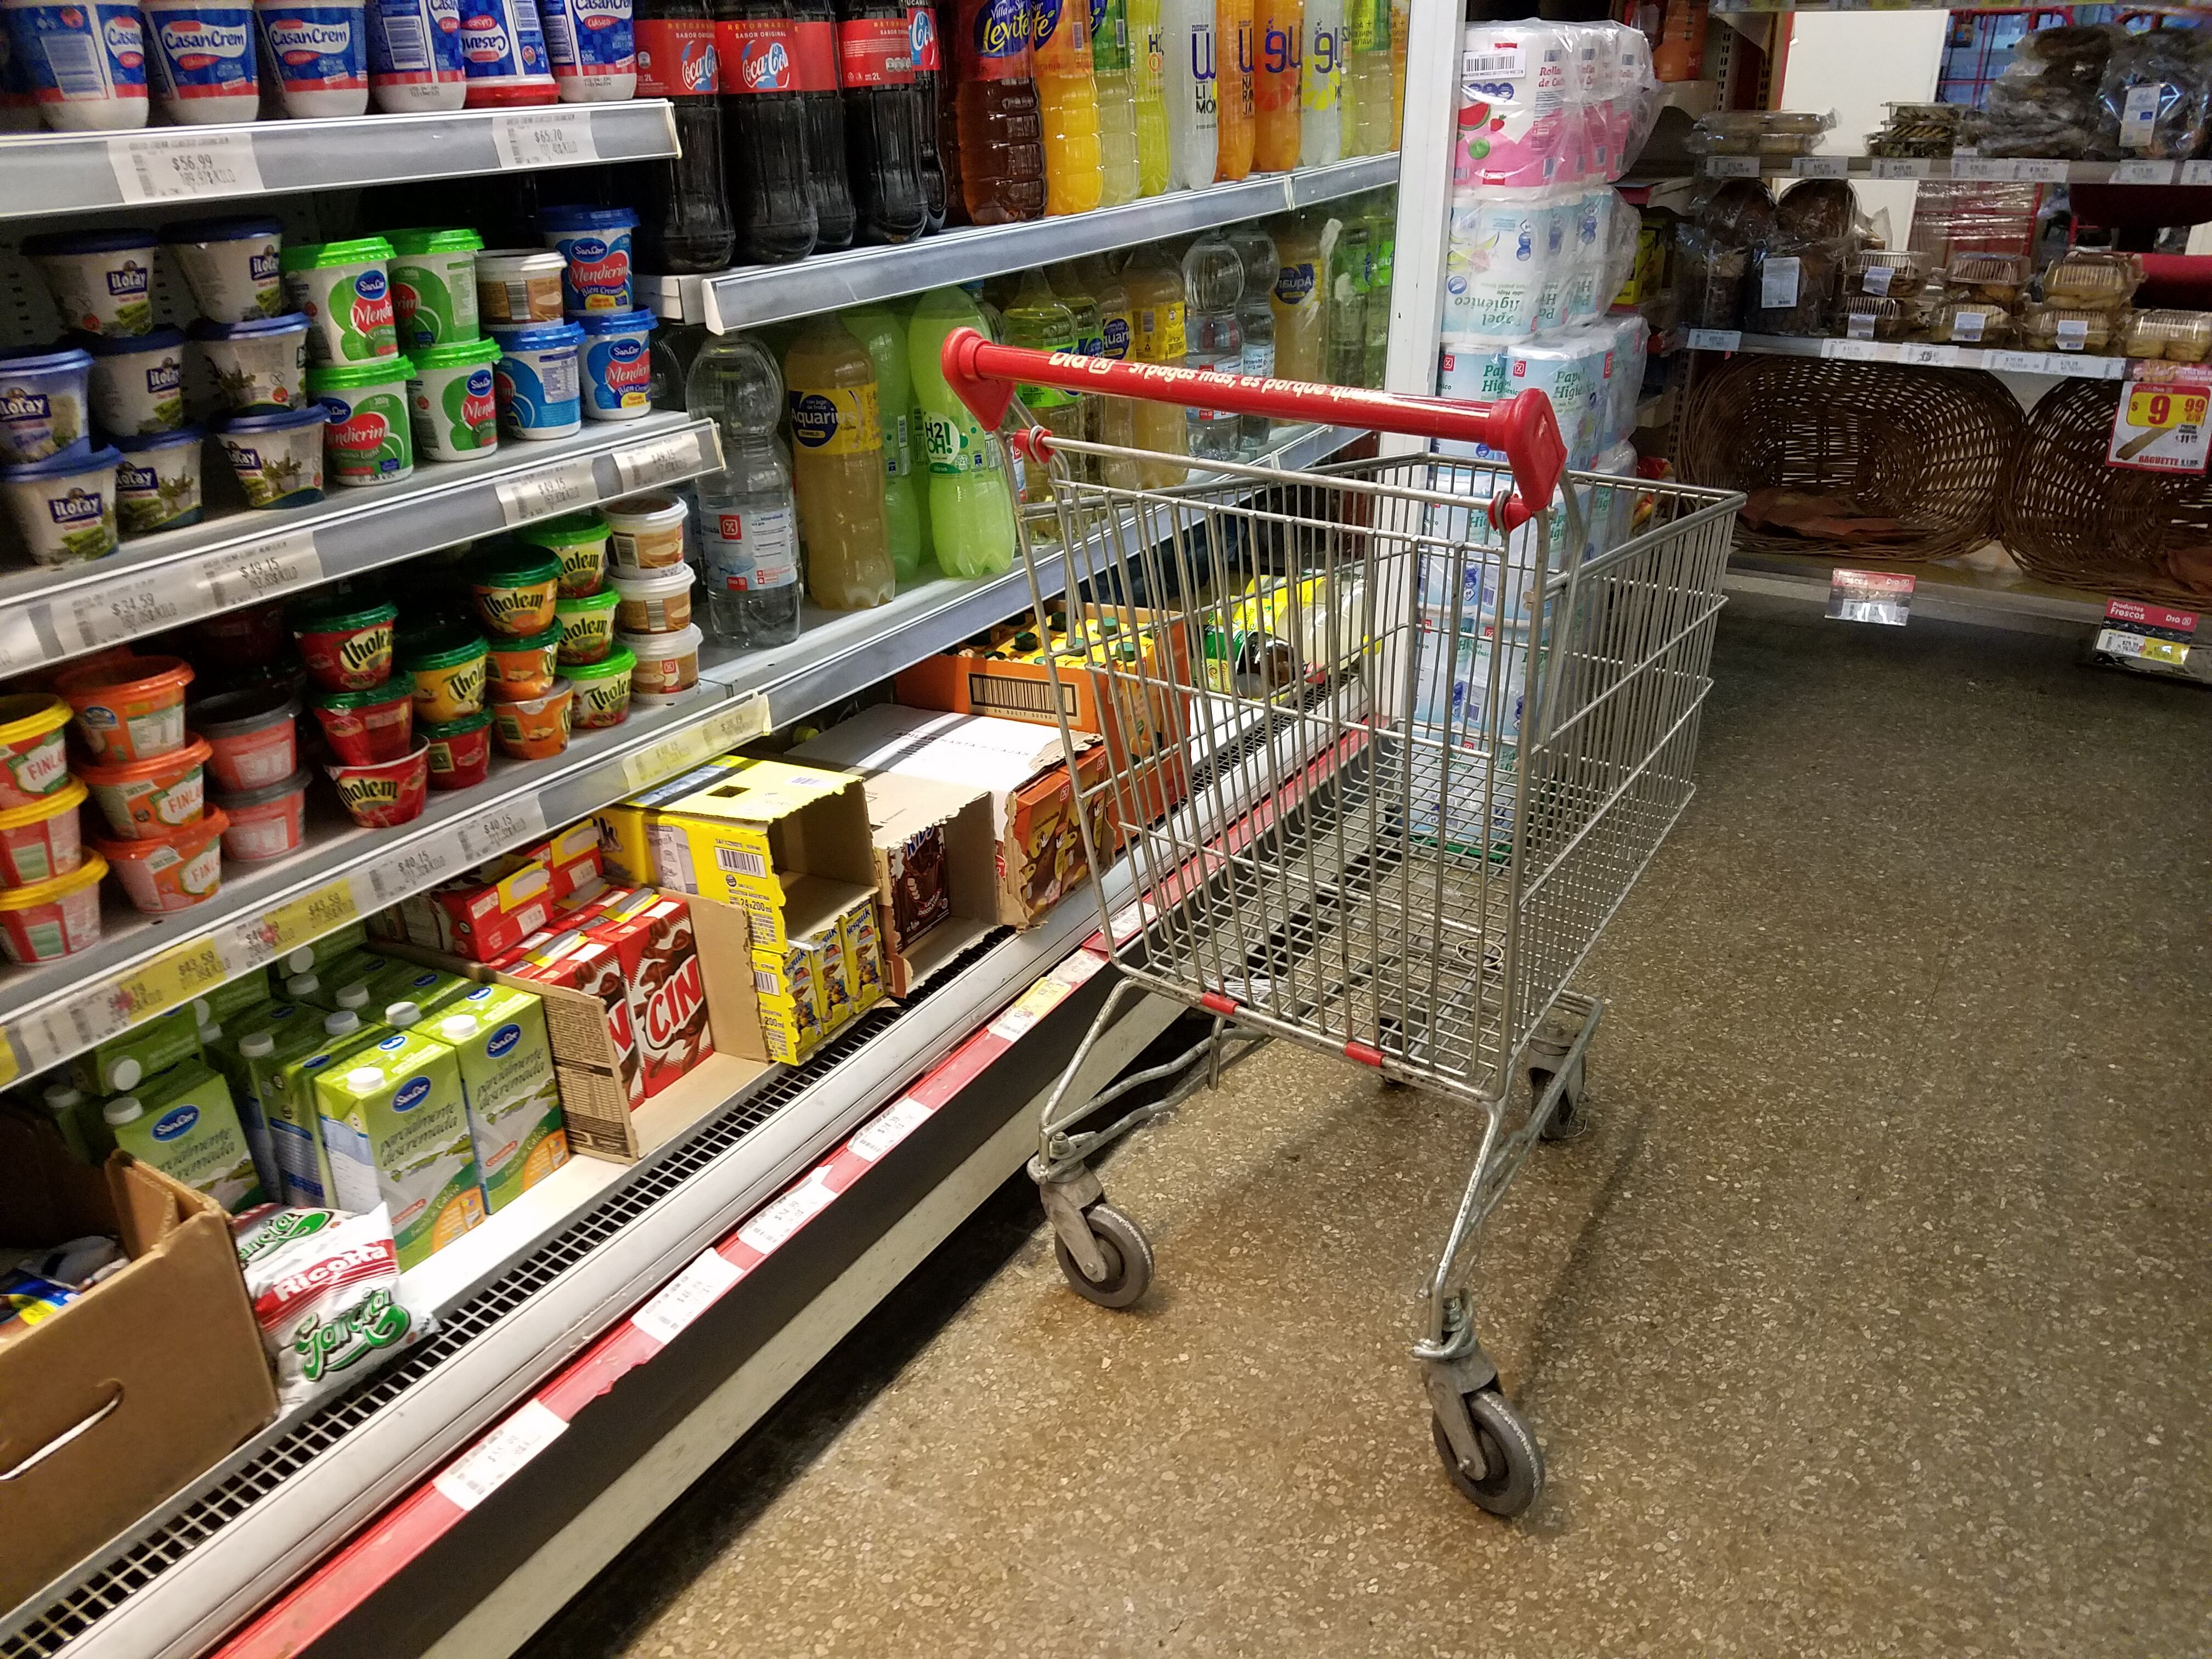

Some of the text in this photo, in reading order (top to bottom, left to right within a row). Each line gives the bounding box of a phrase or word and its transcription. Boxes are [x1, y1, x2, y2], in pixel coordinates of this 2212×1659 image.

[1240, 375, 1262, 388] es
[1261, 377, 1328, 398] porque
[791, 407, 857, 428] Aquarius
[2147, 395, 2171, 425] 9
[2138, 455, 2180, 466] BAGUETTE
[2110, 607, 2181, 624] Frescos Dia
[2112, 601, 2144, 613] Productos
[846, 907, 871, 938] Nesquik
